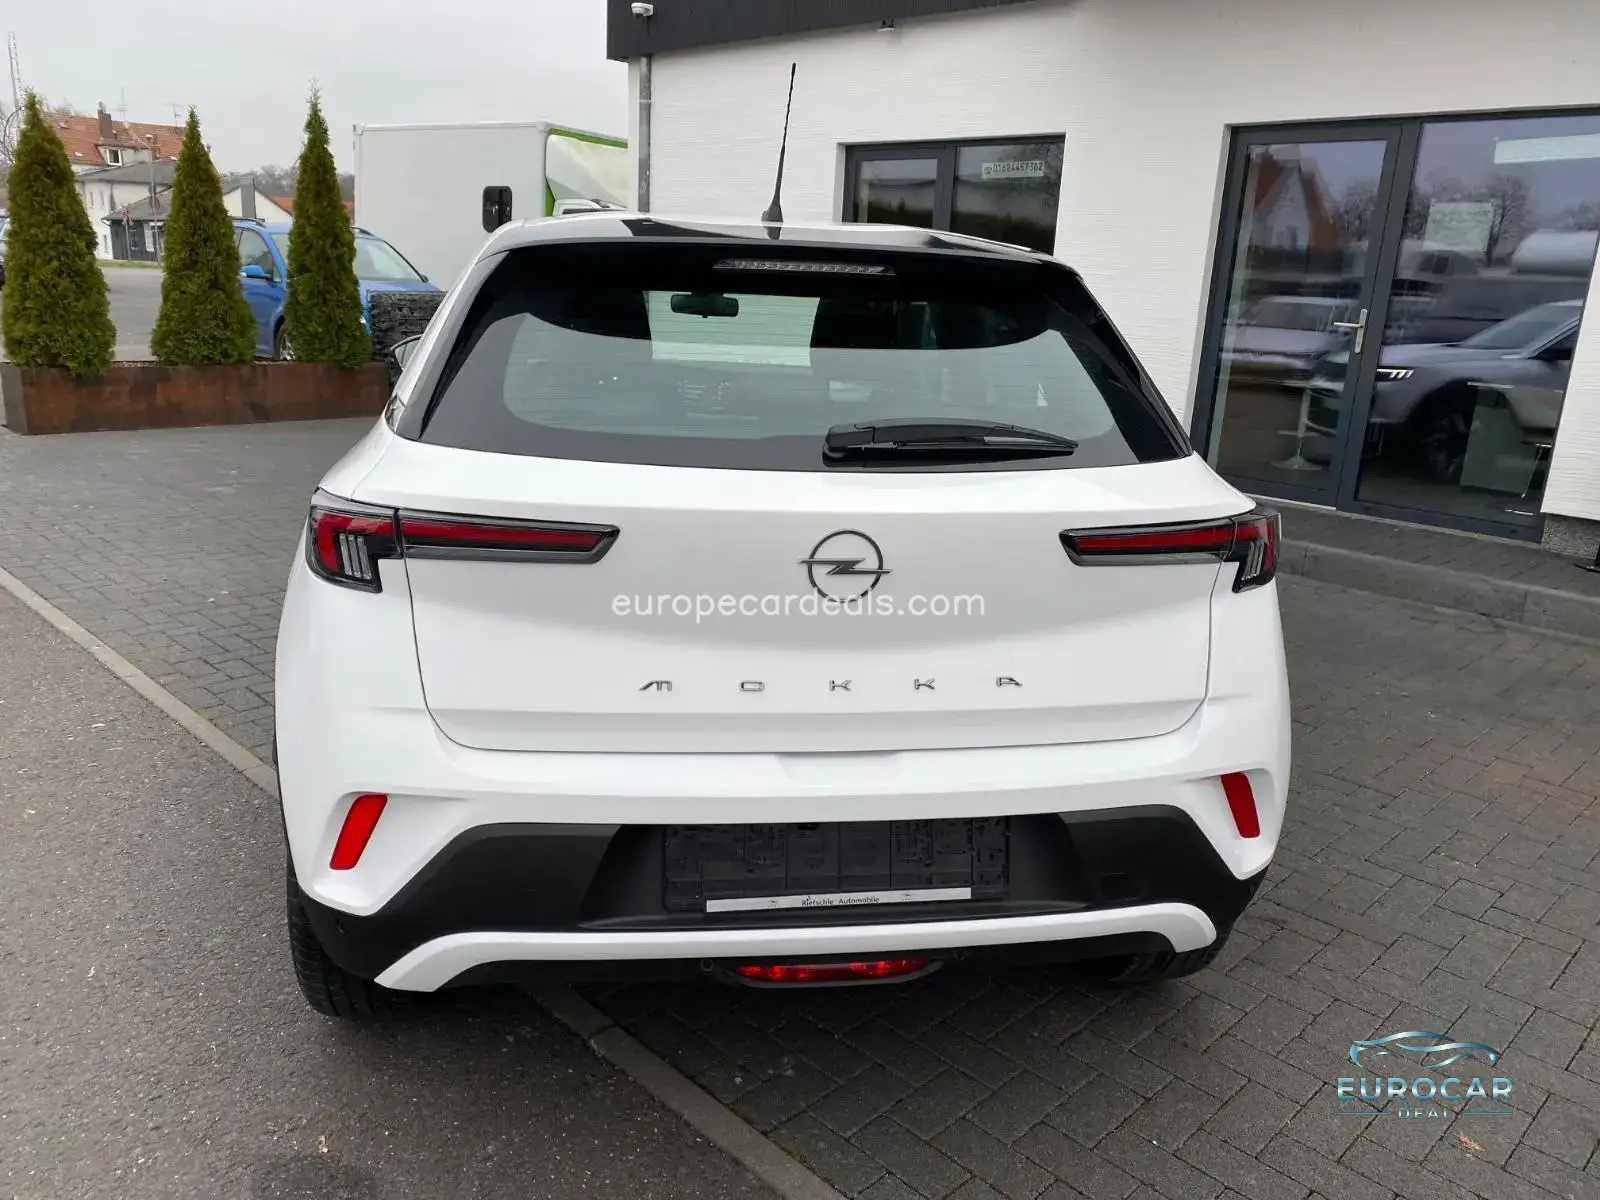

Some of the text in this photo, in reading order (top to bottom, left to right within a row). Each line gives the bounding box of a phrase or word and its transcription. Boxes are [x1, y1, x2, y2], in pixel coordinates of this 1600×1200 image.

[638, 676, 1023, 693] MOKKA
[801, 896, 880, 908] Rietschle Automobile
